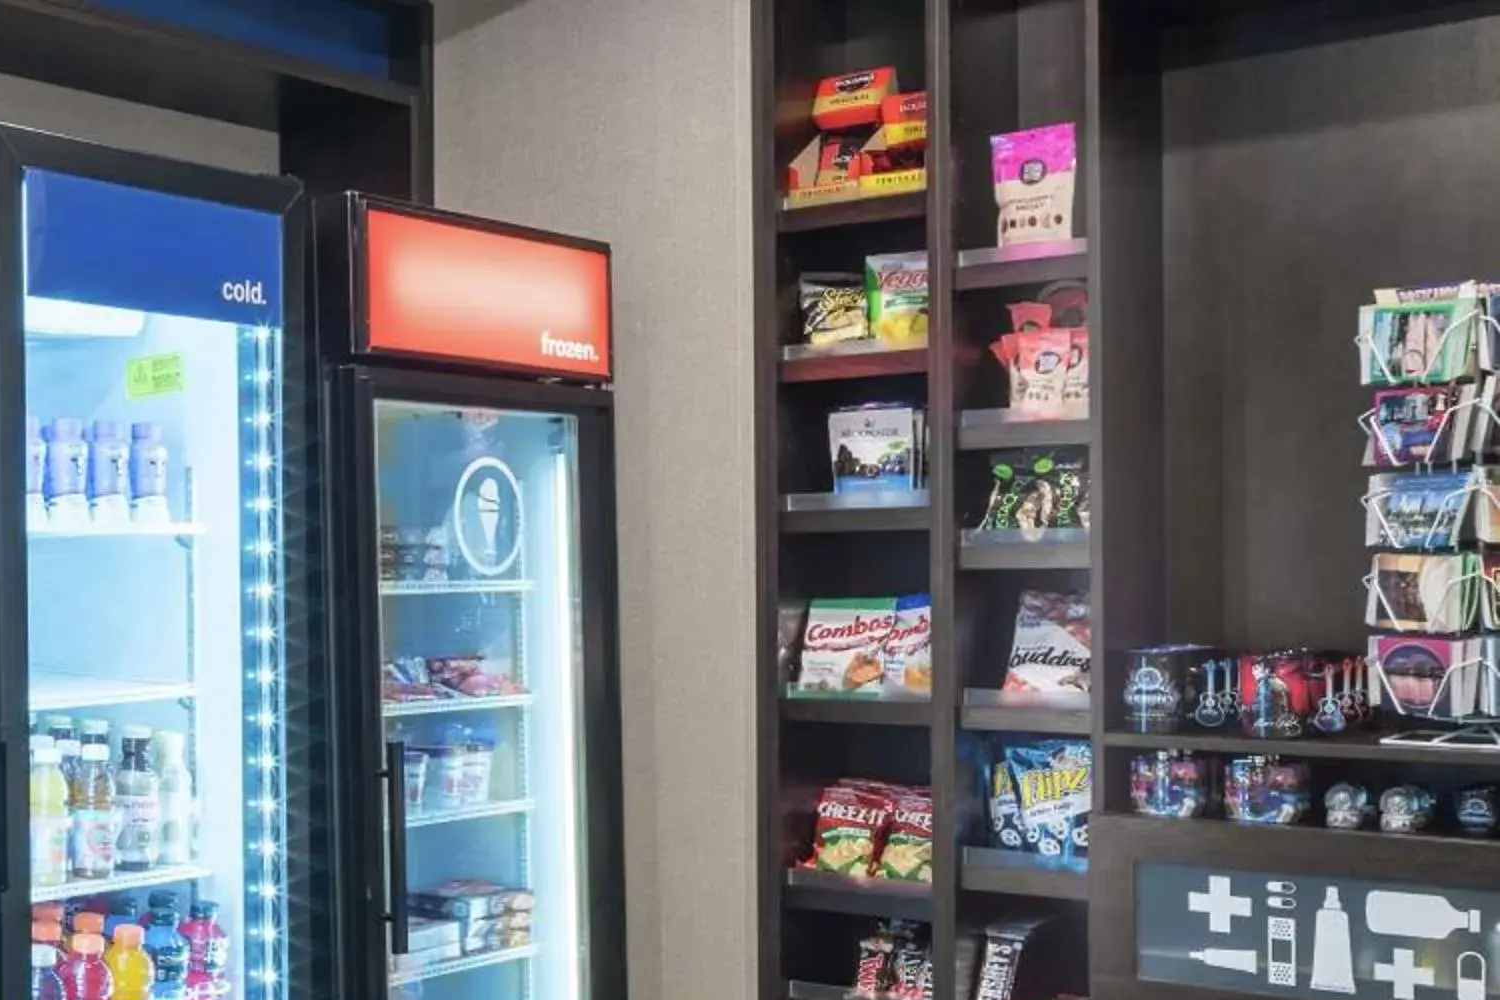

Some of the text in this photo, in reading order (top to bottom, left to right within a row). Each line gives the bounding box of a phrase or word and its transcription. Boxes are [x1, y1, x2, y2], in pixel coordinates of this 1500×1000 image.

[221, 279, 267, 305] cold.
[541, 331, 599, 362] frozen.
[808, 614, 893, 642] Combos
